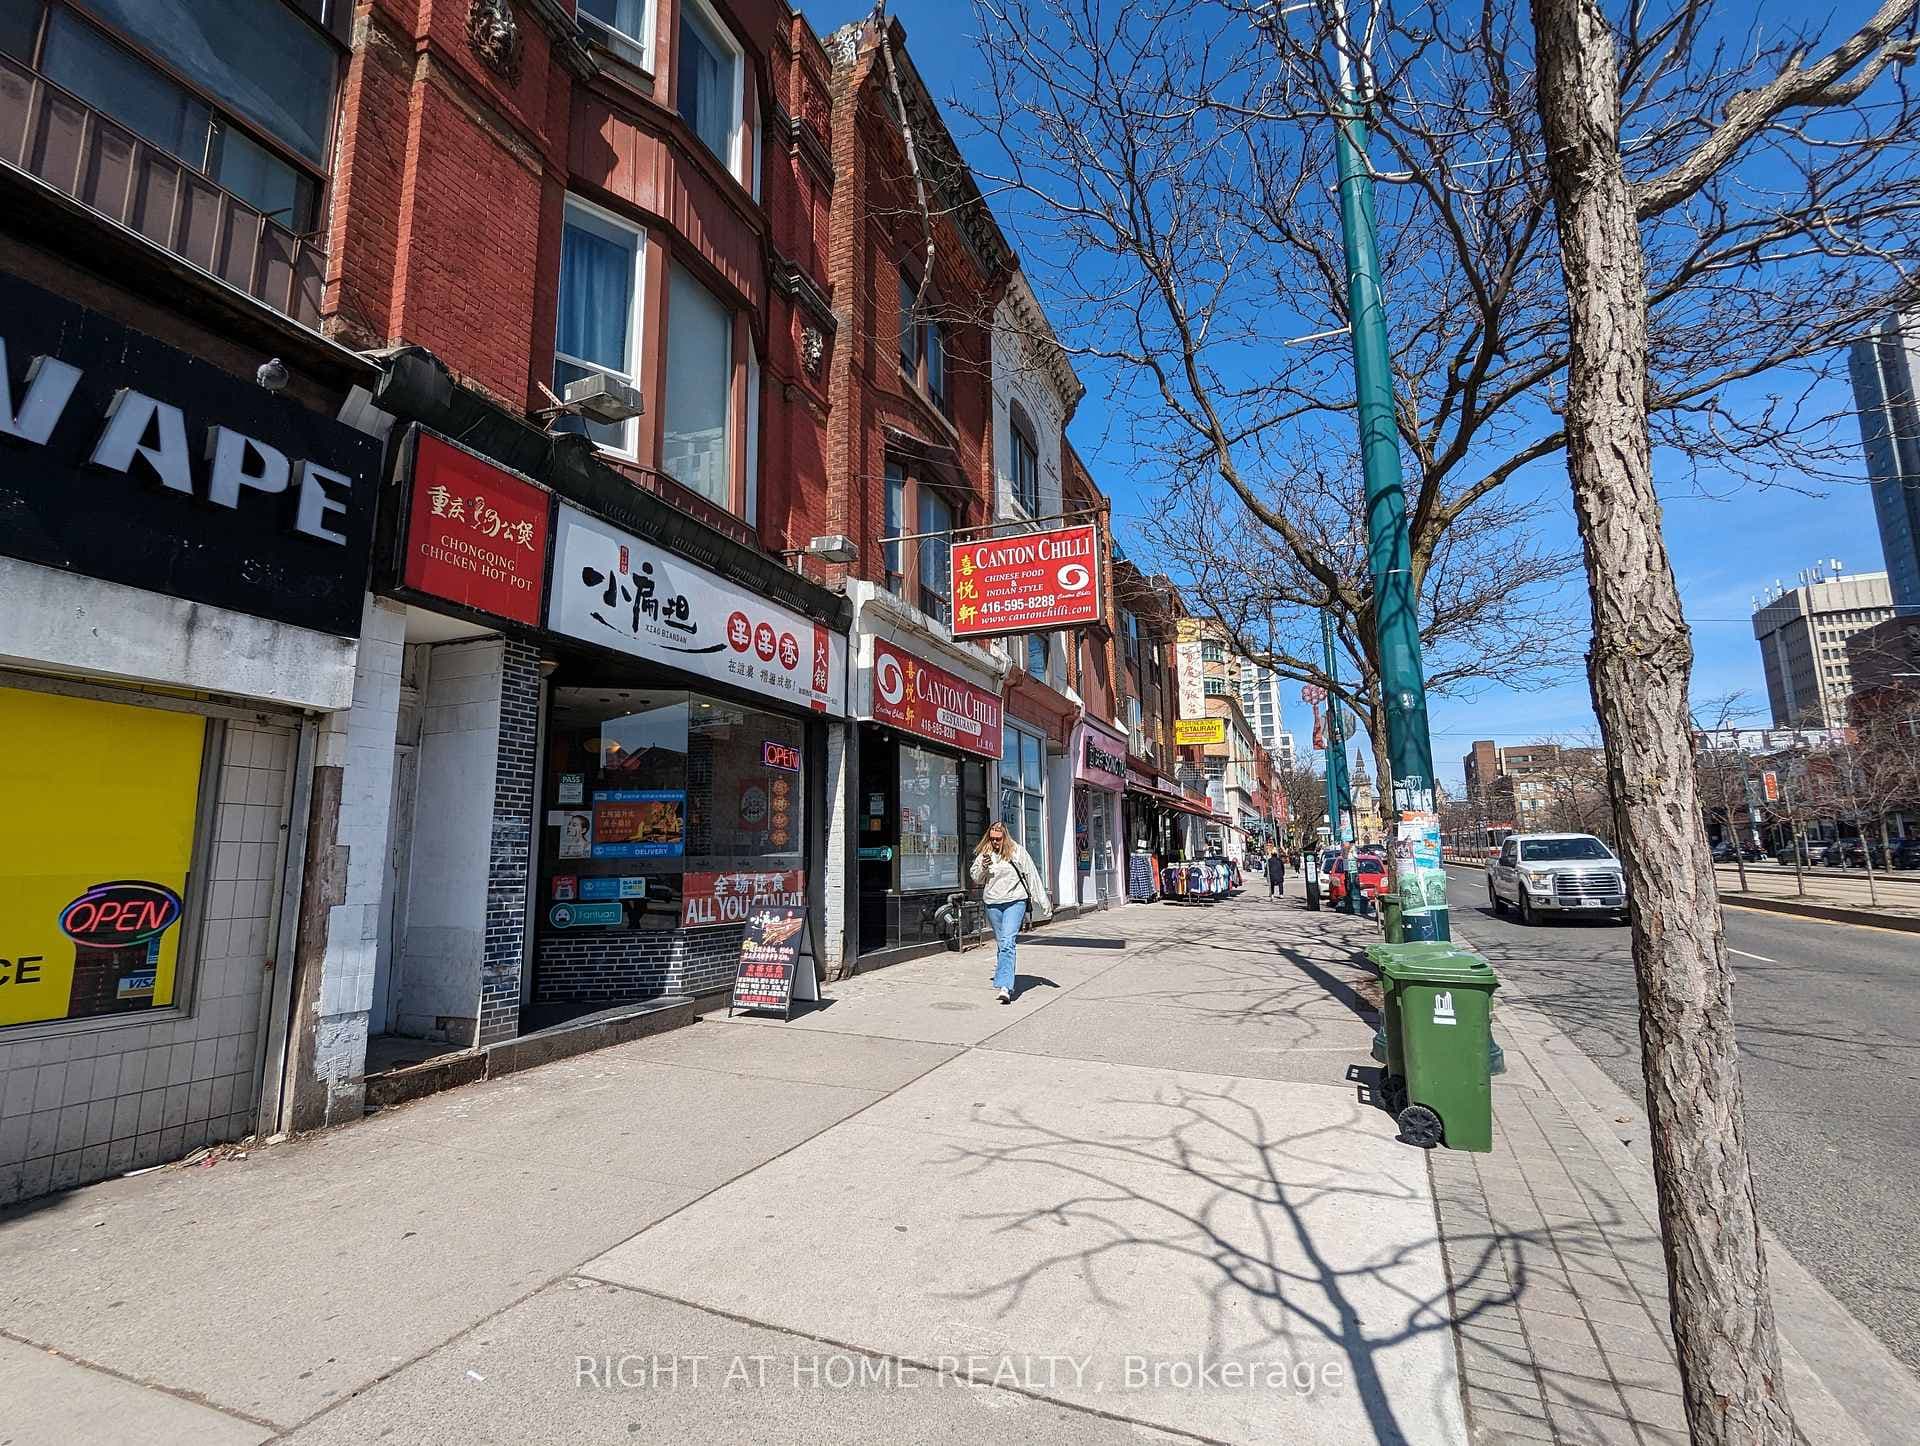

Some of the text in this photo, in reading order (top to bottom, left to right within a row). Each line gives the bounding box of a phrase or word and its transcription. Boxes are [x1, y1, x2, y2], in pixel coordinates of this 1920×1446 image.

[441, 535, 515, 571] CHONGQING
[421, 543, 532, 591] CHICKEN HOT POT
[984, 569, 1044, 583] CHINESE FOOD
[986, 583, 1044, 597] INDIAN STYLE
[981, 595, 1055, 614] 416-595-8288
[981, 605, 1092, 625] www.cantonchilli.com
[941, 711, 978, 733] RESTAURANT
[767, 745, 799, 768] OPEN
[634, 848, 668, 856] DELIVERY
[64, 901, 170, 933] OPEN
[686, 897, 716, 924] ALL
[717, 894, 749, 921] YOU
